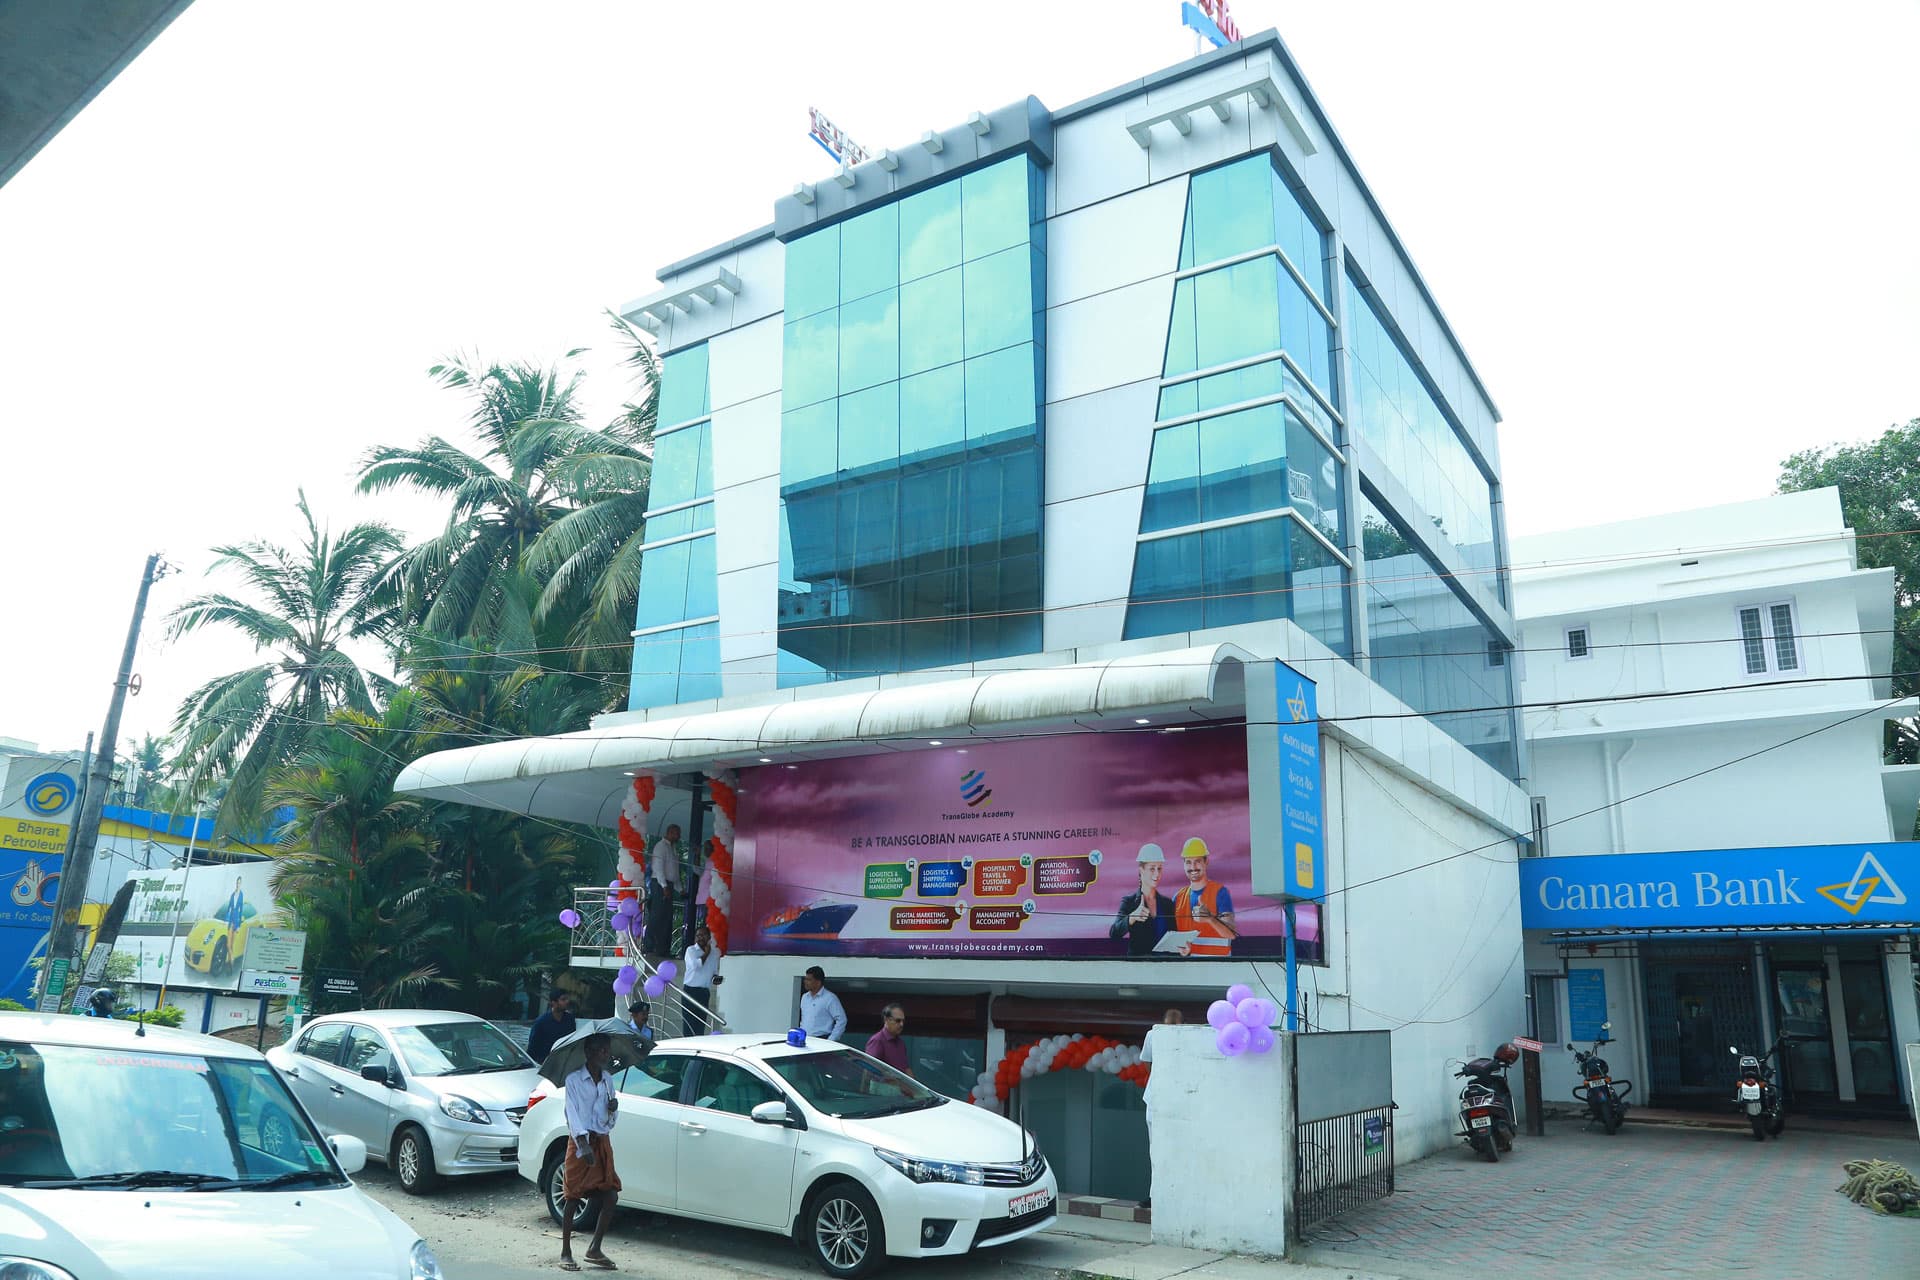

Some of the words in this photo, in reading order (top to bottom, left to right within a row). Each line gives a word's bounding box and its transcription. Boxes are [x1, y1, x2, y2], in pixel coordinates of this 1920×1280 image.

[942, 812, 980, 821] TransGlobe
[982, 810, 1015, 819] Academy
[1286, 803, 1305, 821] Canara
[1304, 811, 1318, 827] Bank
[17, 822, 60, 837] Bharat
[851, 838, 863, 848] BE
[865, 837, 873, 847] A
[876, 833, 955, 847] TRANSGLOBIAN
[958, 833, 1001, 844] NAVIGATE
[1003, 833, 1010, 842] A
[1012, 829, 1061, 842] STUNNING
[1063, 828, 1099, 838] CAREER
[1101, 827, 1121, 837] IN...
[1539, 876, 1681, 911] Canara
[1692, 869, 1806, 908] Bank
[16, 911, 28, 920] for
[908, 942, 1044, 952] www.transglobeacademy.com
